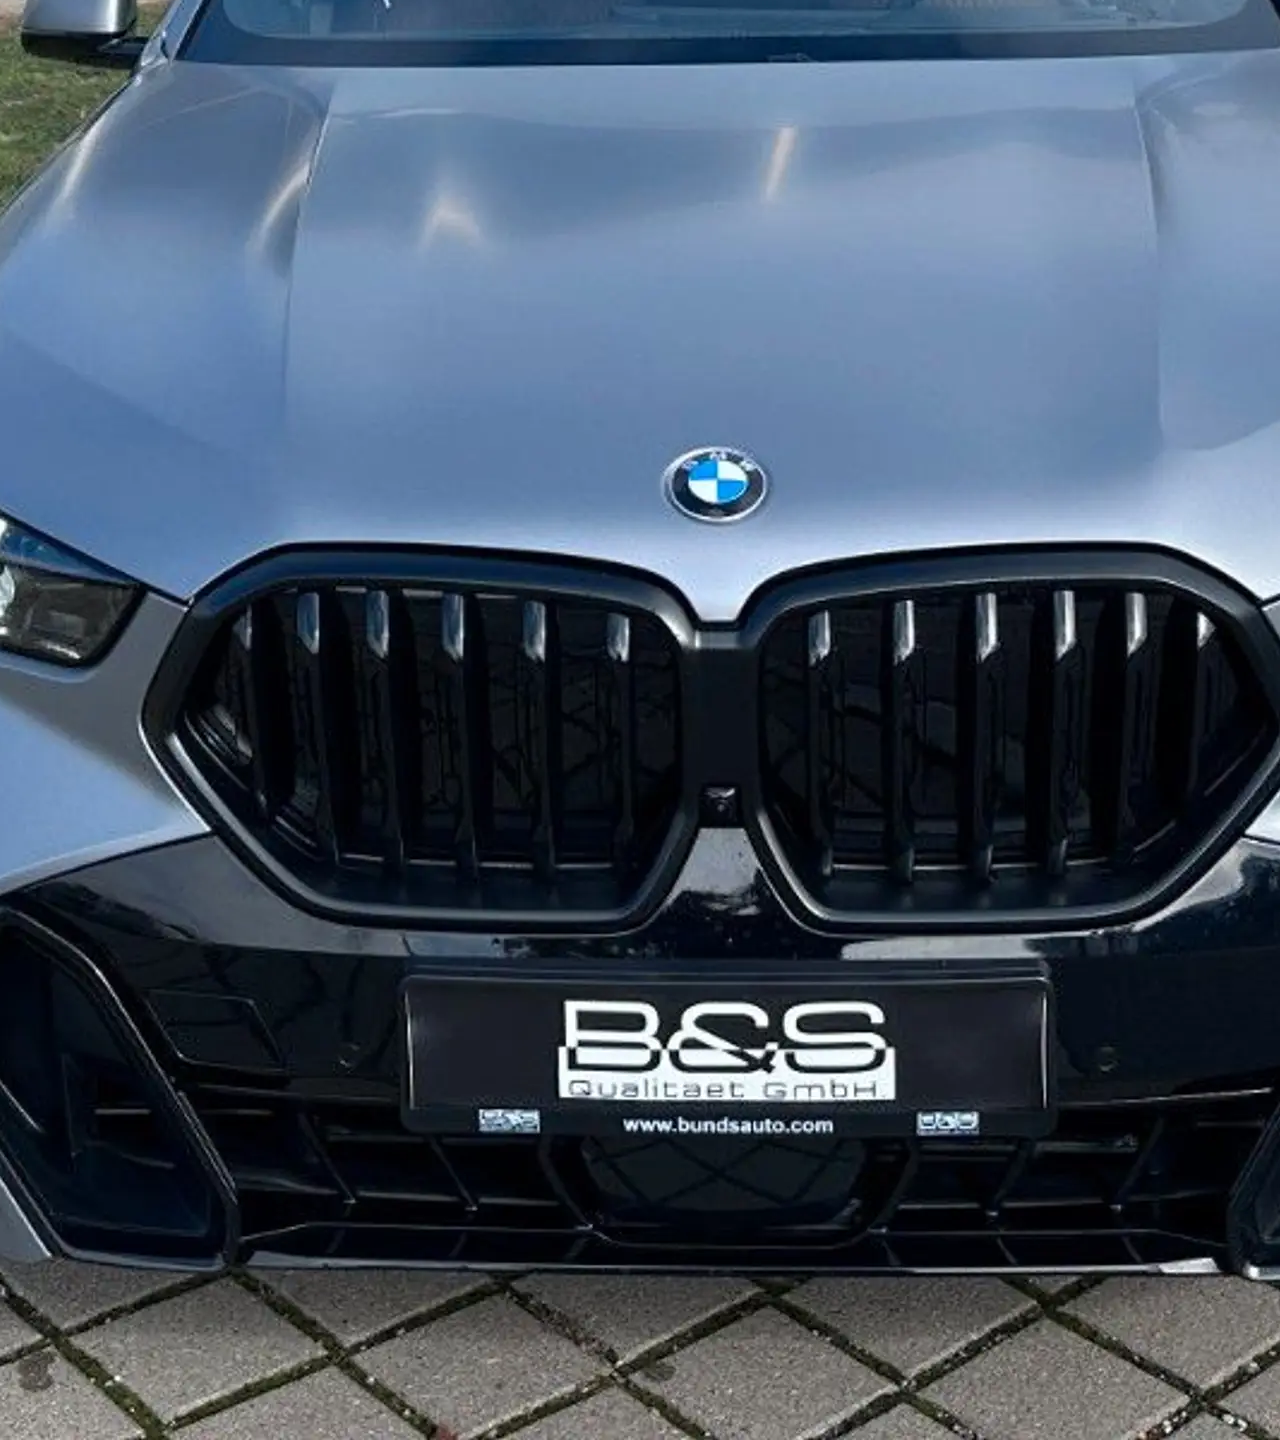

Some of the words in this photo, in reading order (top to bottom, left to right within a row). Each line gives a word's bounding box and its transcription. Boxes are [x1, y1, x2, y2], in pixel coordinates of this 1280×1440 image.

[565, 1000, 888, 1074] B&S
[568, 1079, 745, 1099] Qualitaet
[623, 1115, 834, 1134] www.bundsauto.com
